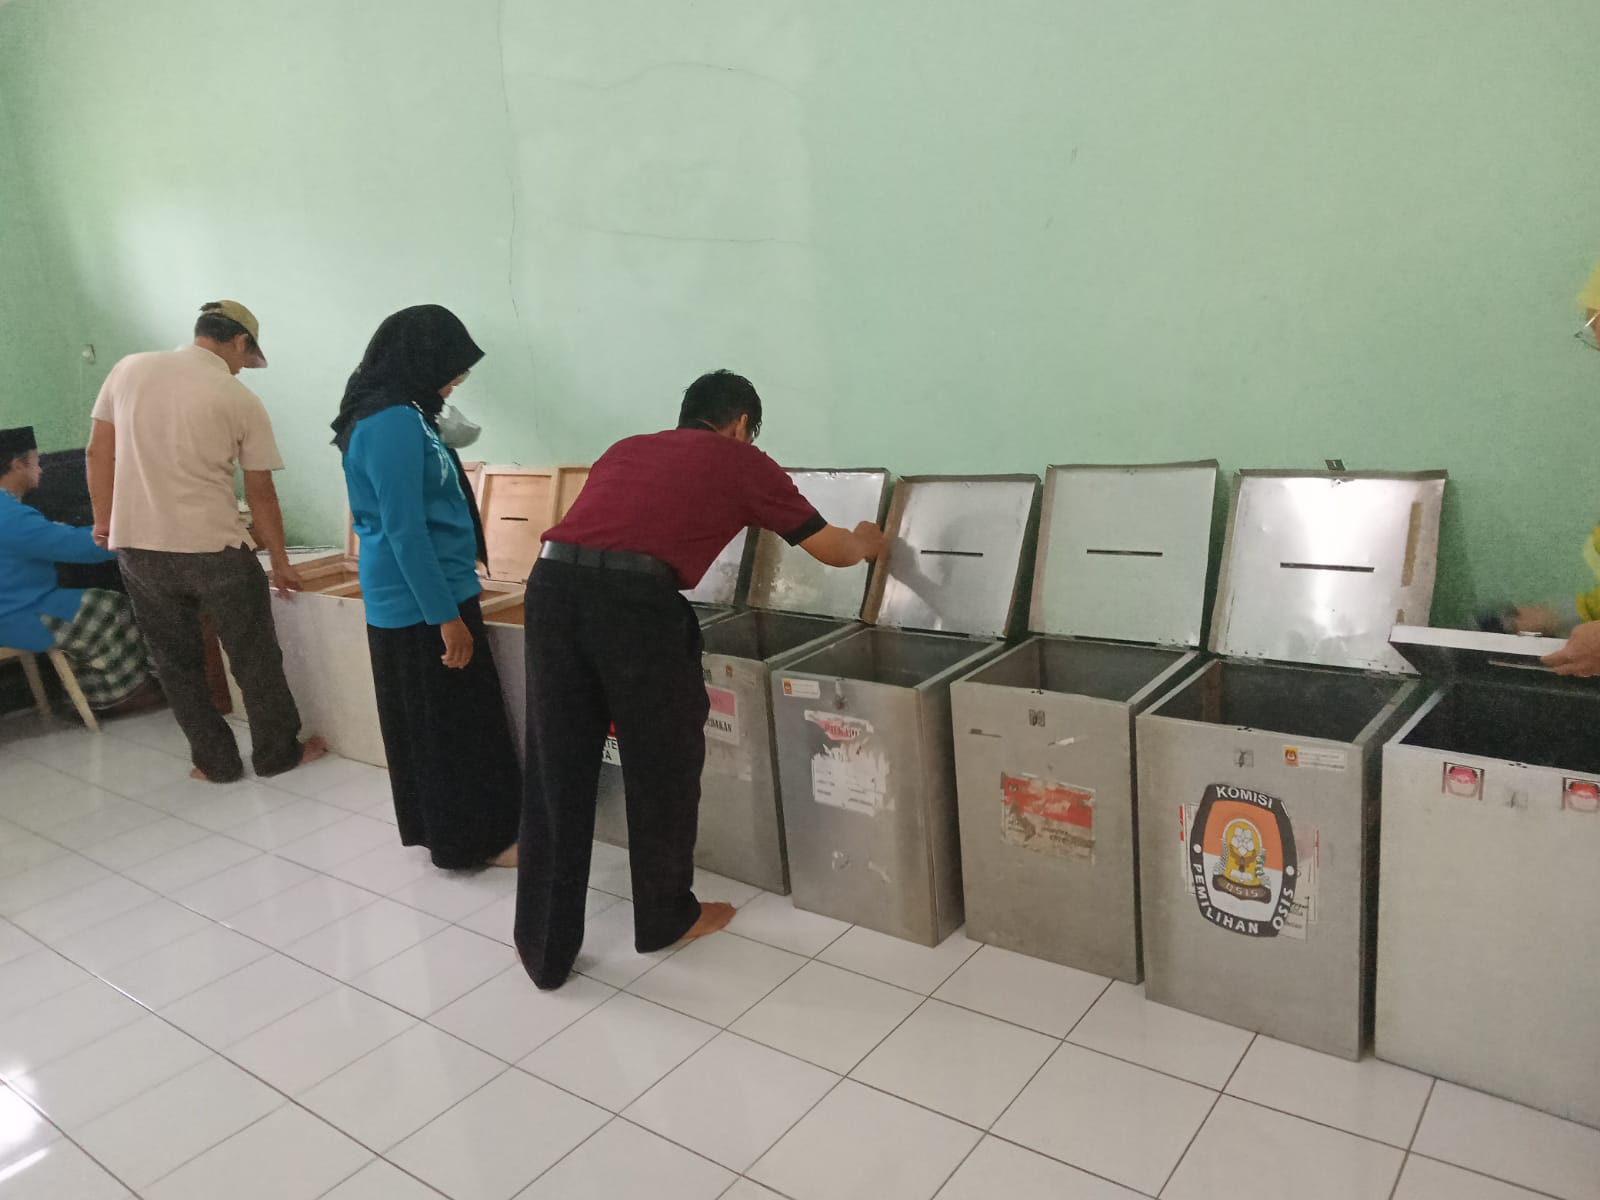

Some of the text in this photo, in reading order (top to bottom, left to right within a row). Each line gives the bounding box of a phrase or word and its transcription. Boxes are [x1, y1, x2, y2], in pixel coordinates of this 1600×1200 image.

[1215, 785, 1273, 809] KOMISI
[1192, 863, 1260, 935] PEMILIHAN
[1272, 887, 1295, 930] OSIS
